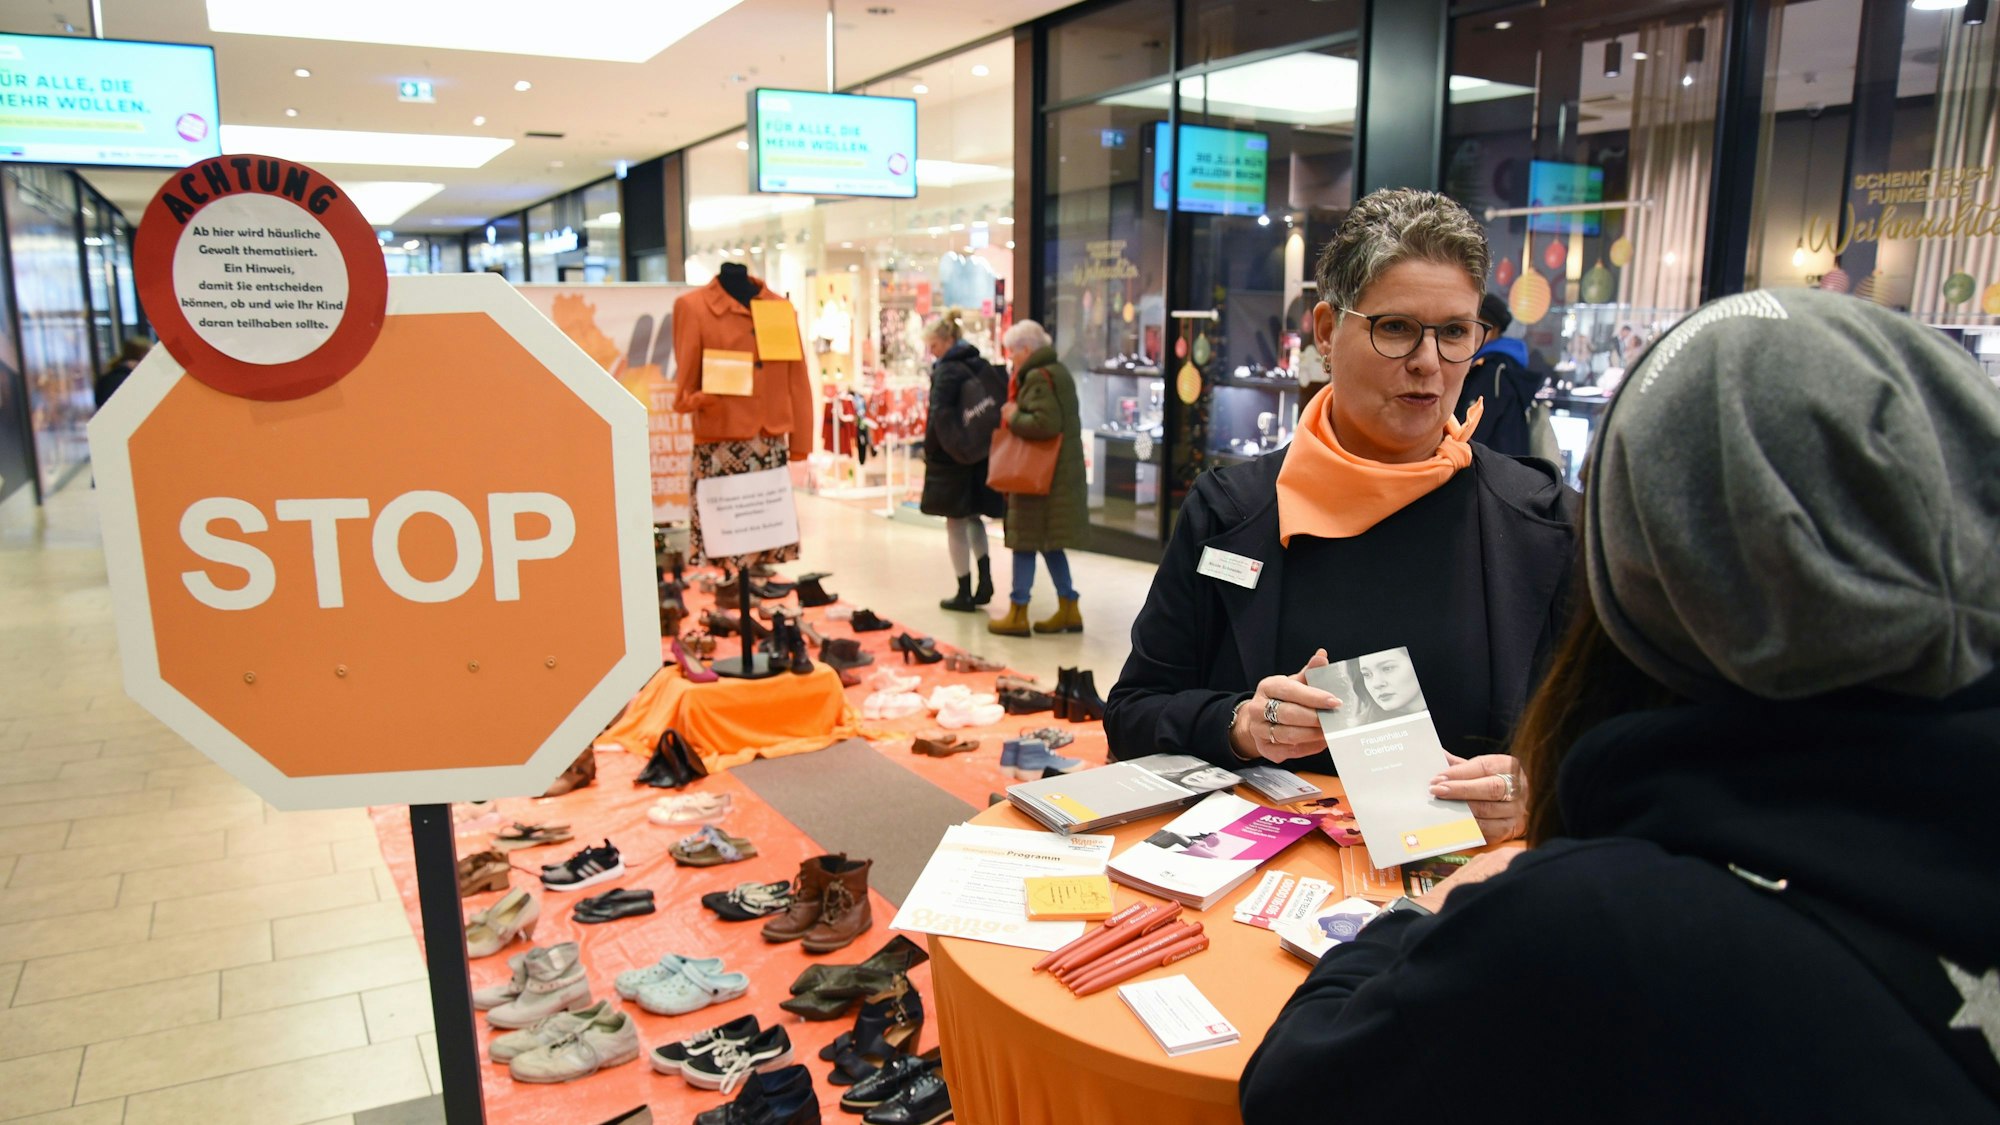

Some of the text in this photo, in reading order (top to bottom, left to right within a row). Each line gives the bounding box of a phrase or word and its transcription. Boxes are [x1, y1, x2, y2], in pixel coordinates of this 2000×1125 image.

[36, 75, 94, 93] ALLE,
[100, 78, 134, 94] DIE
[56, 96, 151, 114] WOLLEN.
[1854, 165, 1994, 190] SCHENKT EUCH
[161, 158, 338, 224] ACHTUNG
[1867, 184, 1972, 205] FUNKELNDE
[192, 226, 321, 239] Ab hier wird häusliche
[198, 245, 318, 257] Gewalt thematisiert.
[224, 263, 295, 275] Ein Hinweis,
[198, 280, 323, 293] damit Sie entscheiden
[181, 297, 344, 311] können, ob und wie Ihr Kind
[198, 317, 329, 330] daran teilhaben sollte.
[179, 490, 577, 611] STOP
[1259, 814, 1288, 826] ASS
[1006, 850, 1061, 862] Programm
